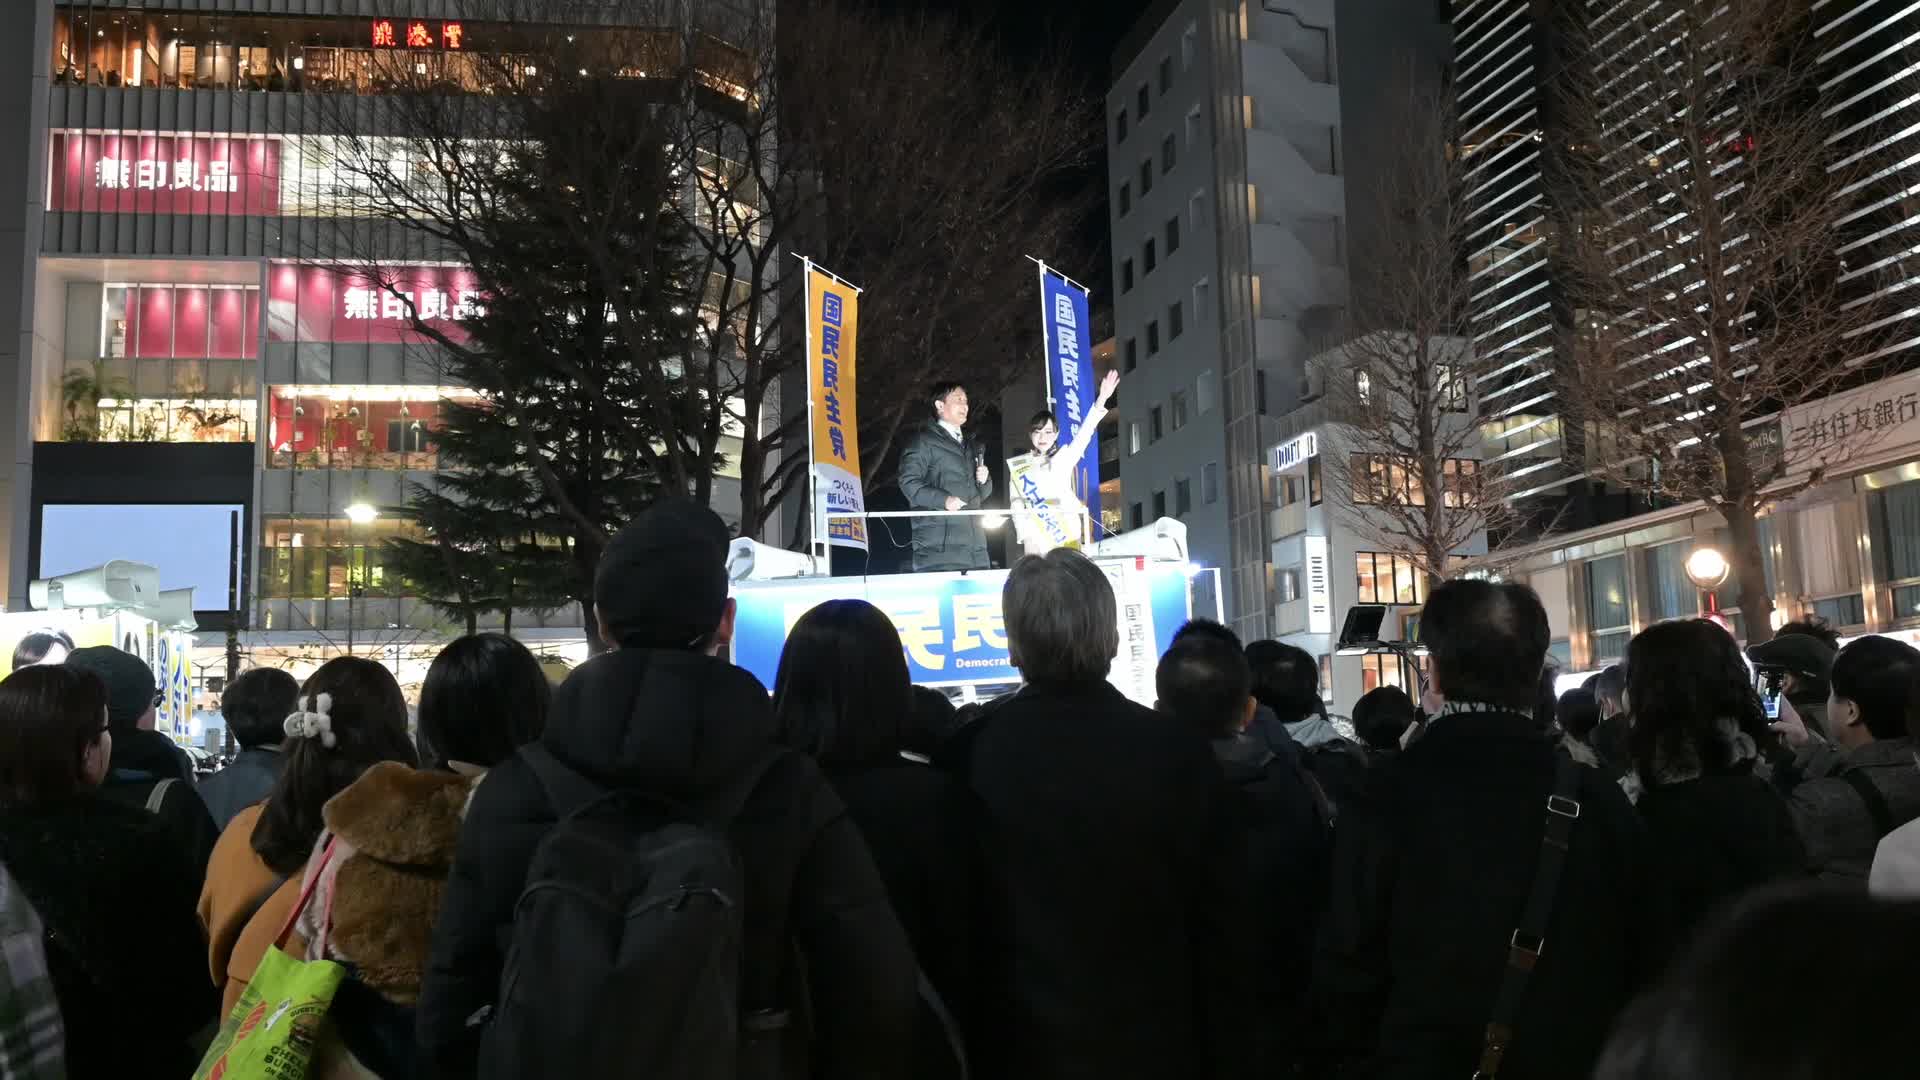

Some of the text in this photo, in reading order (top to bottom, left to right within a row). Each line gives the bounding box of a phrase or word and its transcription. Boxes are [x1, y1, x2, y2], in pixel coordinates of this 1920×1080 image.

[96, 156, 238, 192] 無印良品
[344, 287, 486, 321] 無印良品
[822, 290, 846, 461] 国民民主党
[1791, 392, 1919, 447] 三井住友銀行
